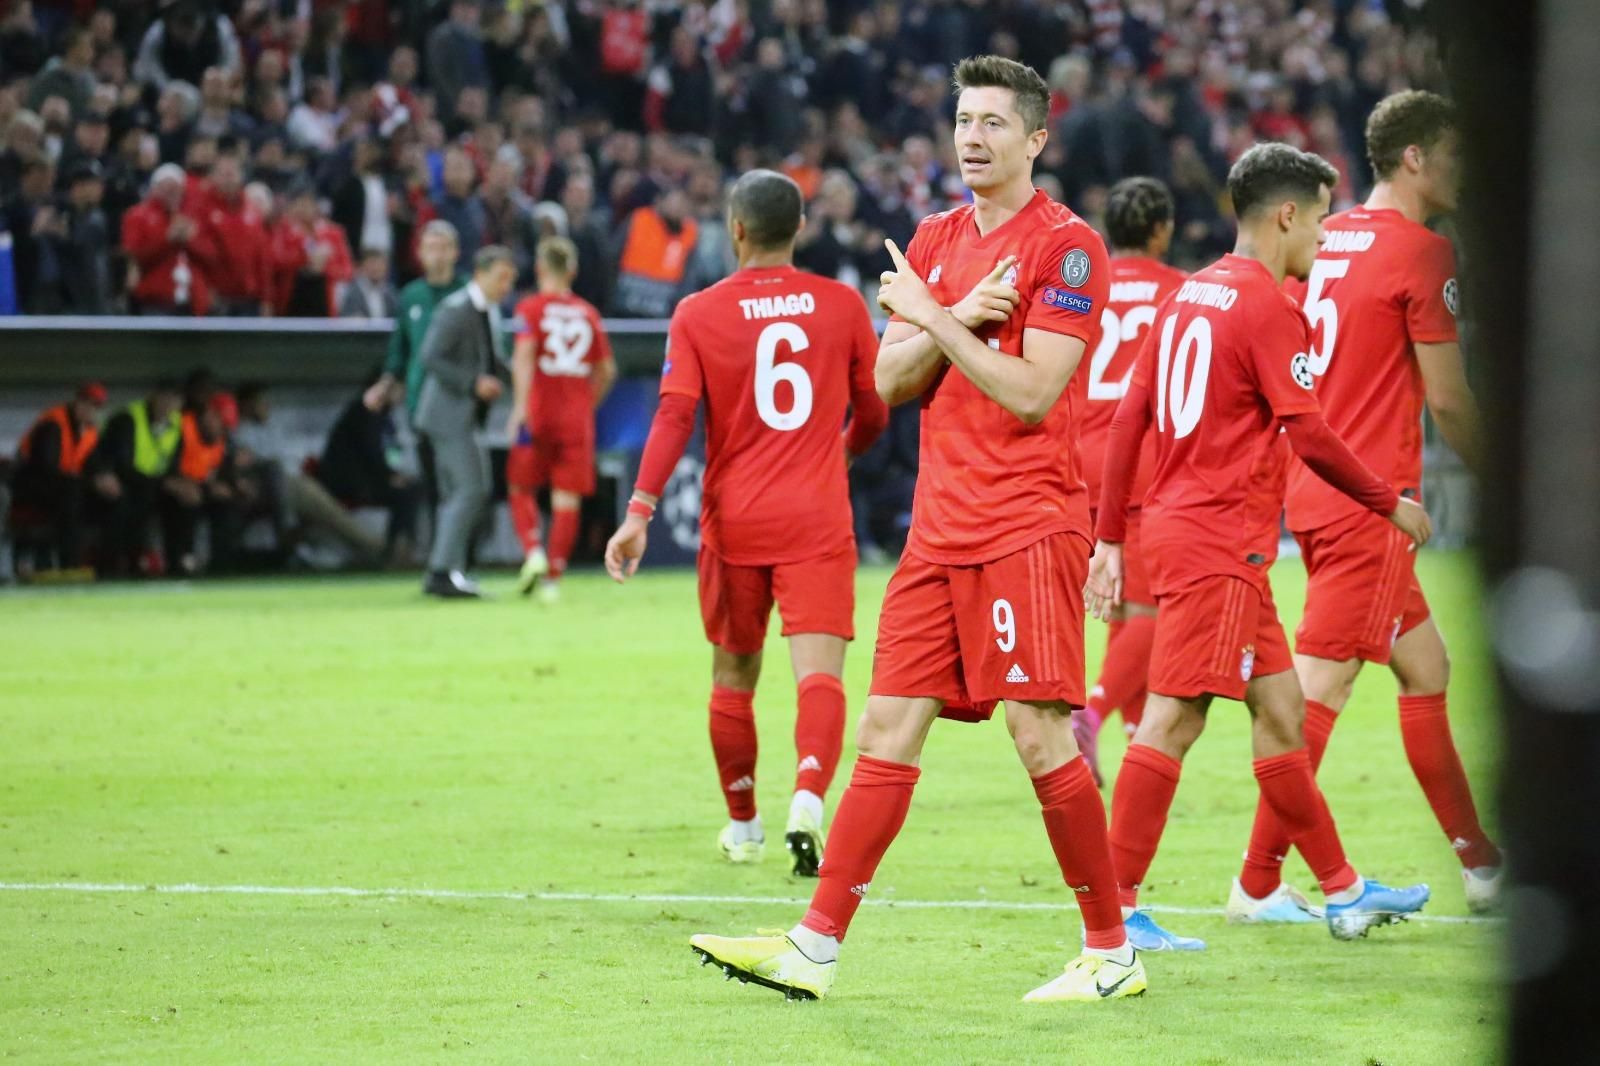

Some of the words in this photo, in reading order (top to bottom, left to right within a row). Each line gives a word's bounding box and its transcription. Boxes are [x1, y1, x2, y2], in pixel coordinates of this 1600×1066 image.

[1320, 230, 1376, 252] AVARD
[1072, 267, 1080, 277] 5
[738, 292, 815, 320] THIAGO
[1057, 294, 1092, 310] RESPECT
[1303, 259, 1350, 376] 5
[539, 316, 593, 377] 32
[754, 321, 813, 431] 6
[1157, 311, 1213, 439] 10
[992, 598, 1016, 653] 9
